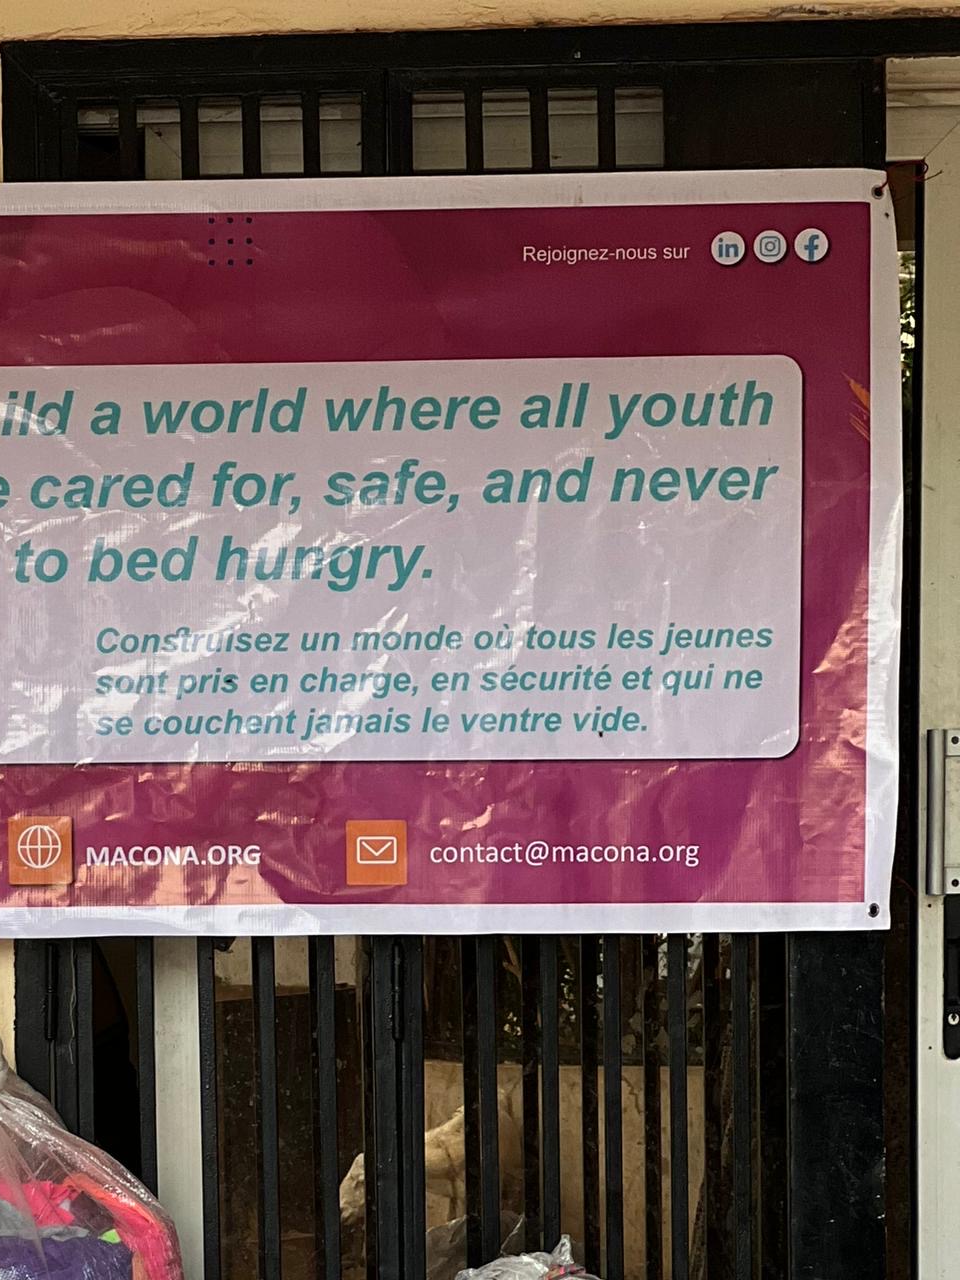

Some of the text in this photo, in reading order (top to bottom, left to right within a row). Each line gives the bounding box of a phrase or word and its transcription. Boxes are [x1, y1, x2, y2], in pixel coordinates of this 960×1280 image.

[523, 246, 691, 266] Rejoignez-nous sur
[90, 400, 122, 435] a
[144, 387, 308, 435] world
[326, 385, 501, 432] where
[520, 382, 590, 430] all
[604, 380, 774, 441] youth
[30, 462, 196, 509] cared
[212, 461, 302, 515] for,
[323, 459, 460, 513] safe,
[482, 457, 595, 504] and
[610, 464, 779, 502] never
[13, 540, 69, 584] to
[88, 535, 199, 583] bed
[215, 535, 434, 593] hungry.
[95, 623, 775, 656] Construisez un monde où tous les jeunes
[95, 663, 764, 701] sont pris en charge, en sécurité et qui ne
[95, 706, 649, 741] se couchent jamais le ventre vide.
[85, 844, 261, 868] MACONA.ORG
[429, 840, 700, 868] contact@macona.org
